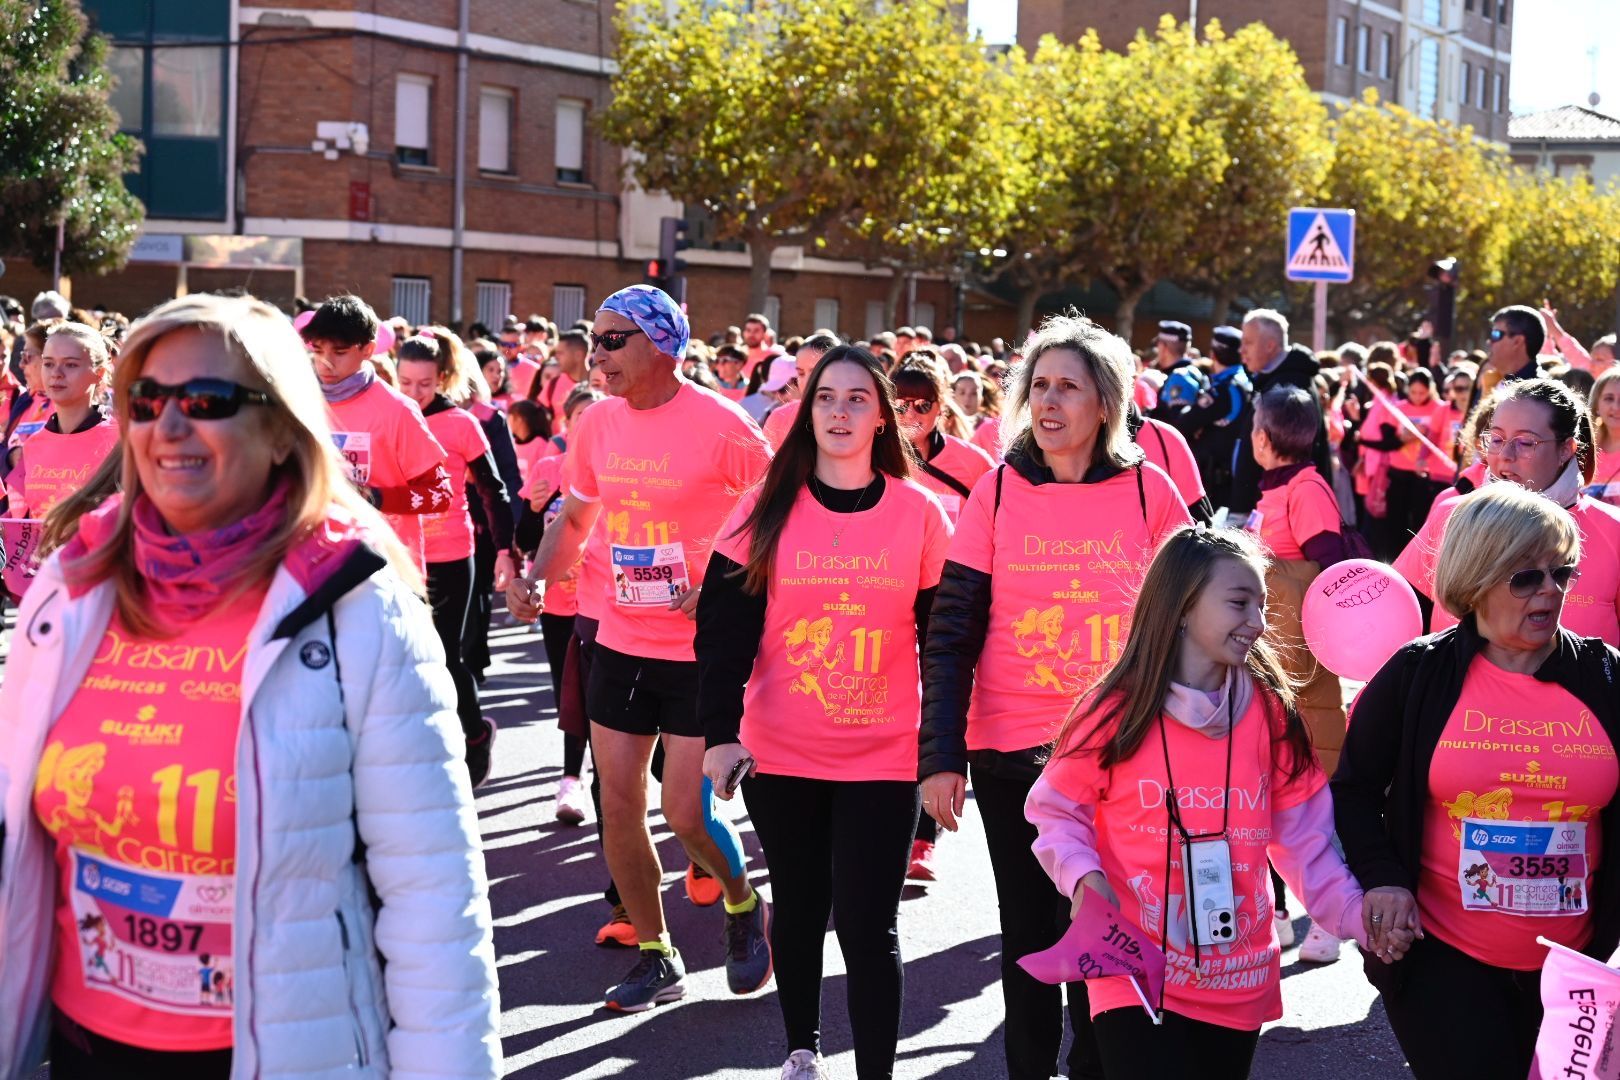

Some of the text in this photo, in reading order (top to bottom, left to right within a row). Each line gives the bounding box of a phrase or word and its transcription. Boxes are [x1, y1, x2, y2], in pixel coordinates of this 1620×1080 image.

[633, 566, 673, 581] 5539
[856, 576, 905, 588] CAROBELS
[1053, 590, 1099, 599] SUZUKI
[1564, 594, 1594, 604] OBELS
[823, 603, 865, 612] SUZUKI
[834, 716, 896, 725] DRASANVI
[100, 719, 184, 739] SUZUKI
[1500, 772, 1568, 785] SUZUKI
[1510, 856, 1570, 878] 3553
[124, 913, 205, 952] 1897
[1195, 966, 1270, 991] DRASANVI
